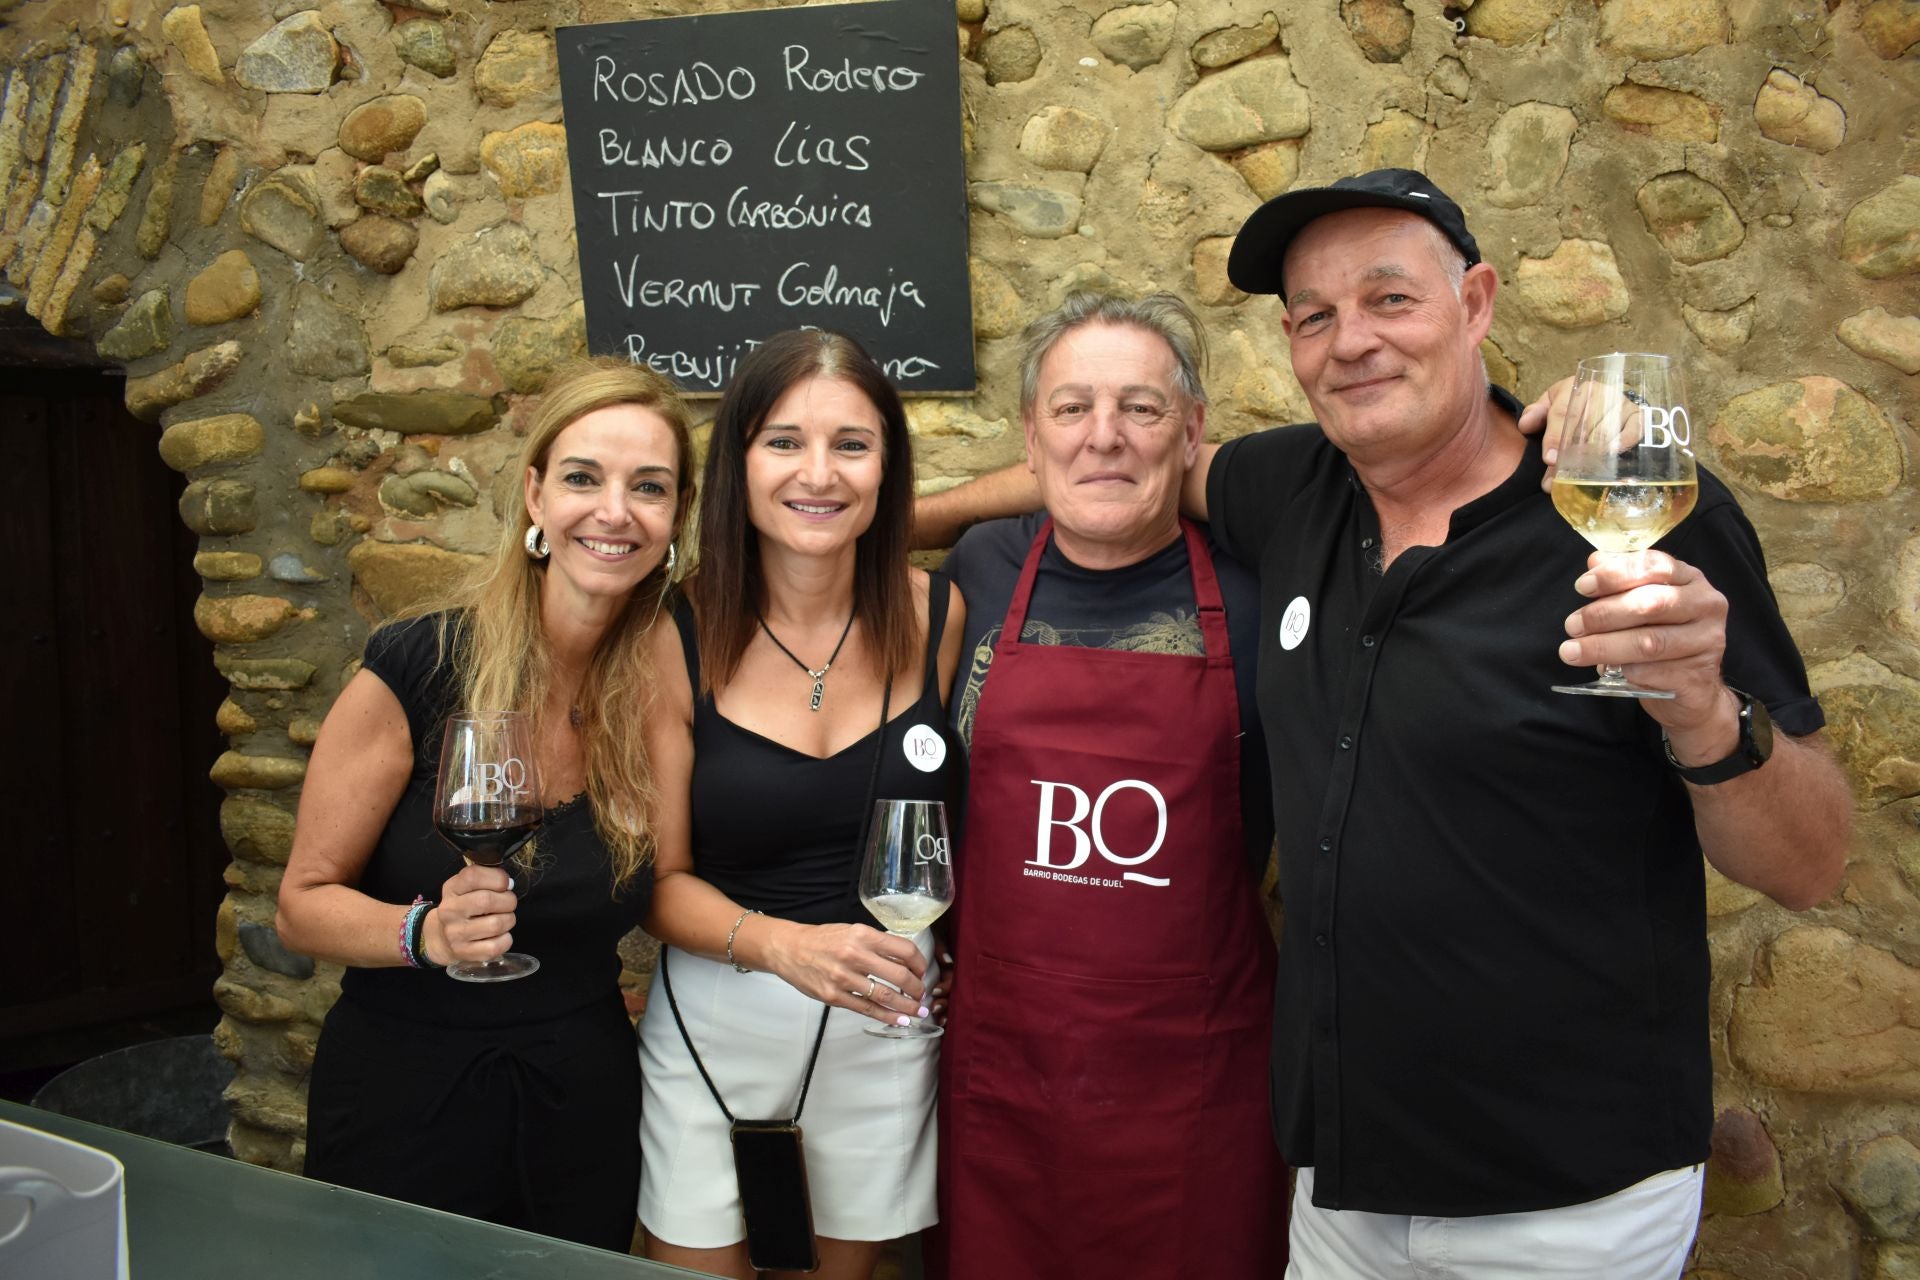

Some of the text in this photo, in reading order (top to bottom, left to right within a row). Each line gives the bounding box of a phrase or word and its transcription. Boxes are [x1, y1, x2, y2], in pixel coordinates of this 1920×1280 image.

[594, 44, 926, 107] ROSADO Rodero
[598, 127, 734, 170] BLANCO
[613, 254, 761, 312] VERMUT
[1638, 404, 1694, 457] BQ
[476, 757, 530, 797] BQ
[1024, 779, 1171, 887] BQ
[1023, 867, 1124, 889] BARRIO BODEGAS DE QUEL
